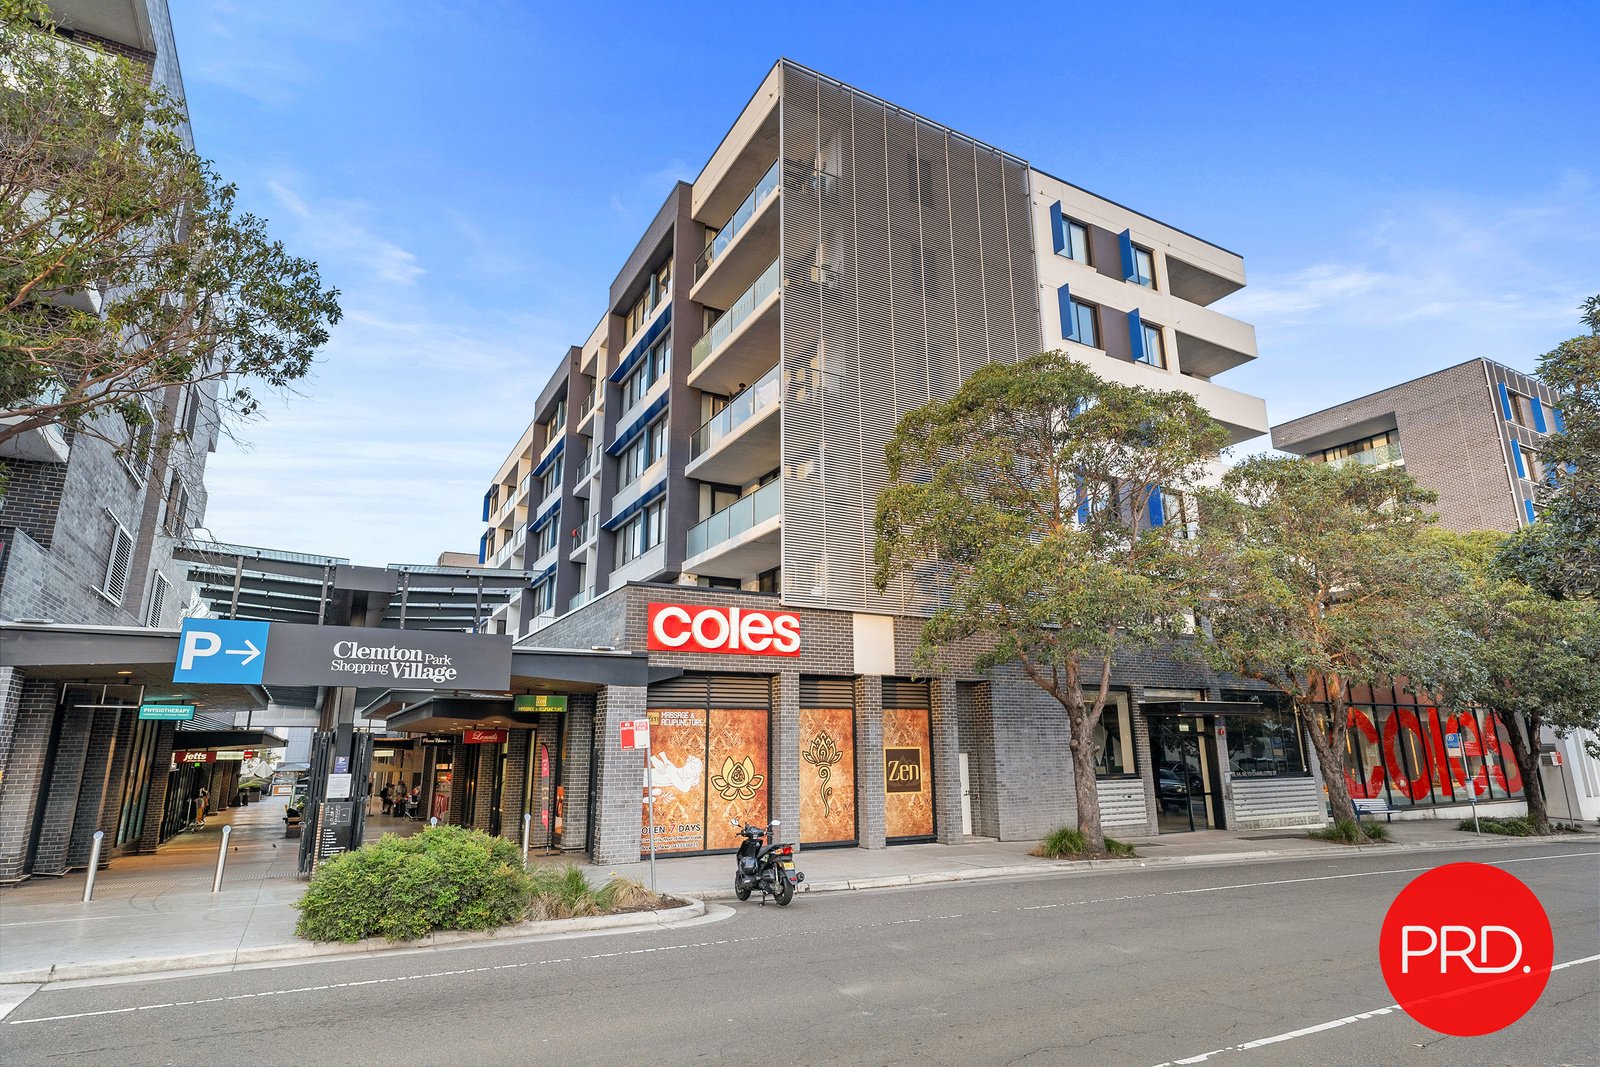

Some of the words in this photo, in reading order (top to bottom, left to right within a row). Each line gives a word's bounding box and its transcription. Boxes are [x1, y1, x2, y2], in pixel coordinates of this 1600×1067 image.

[653, 606, 800, 652] coles
[181, 630, 222, 670] P
[334, 641, 423, 661] Clemton
[424, 654, 452, 665] Park
[331, 660, 389, 675] Shopping
[390, 662, 457, 683] Village
[183, 752, 207, 761] jetts
[888, 760, 919, 781] Zen
[670, 824, 675, 833] 7
[678, 824, 701, 832] DAYS
